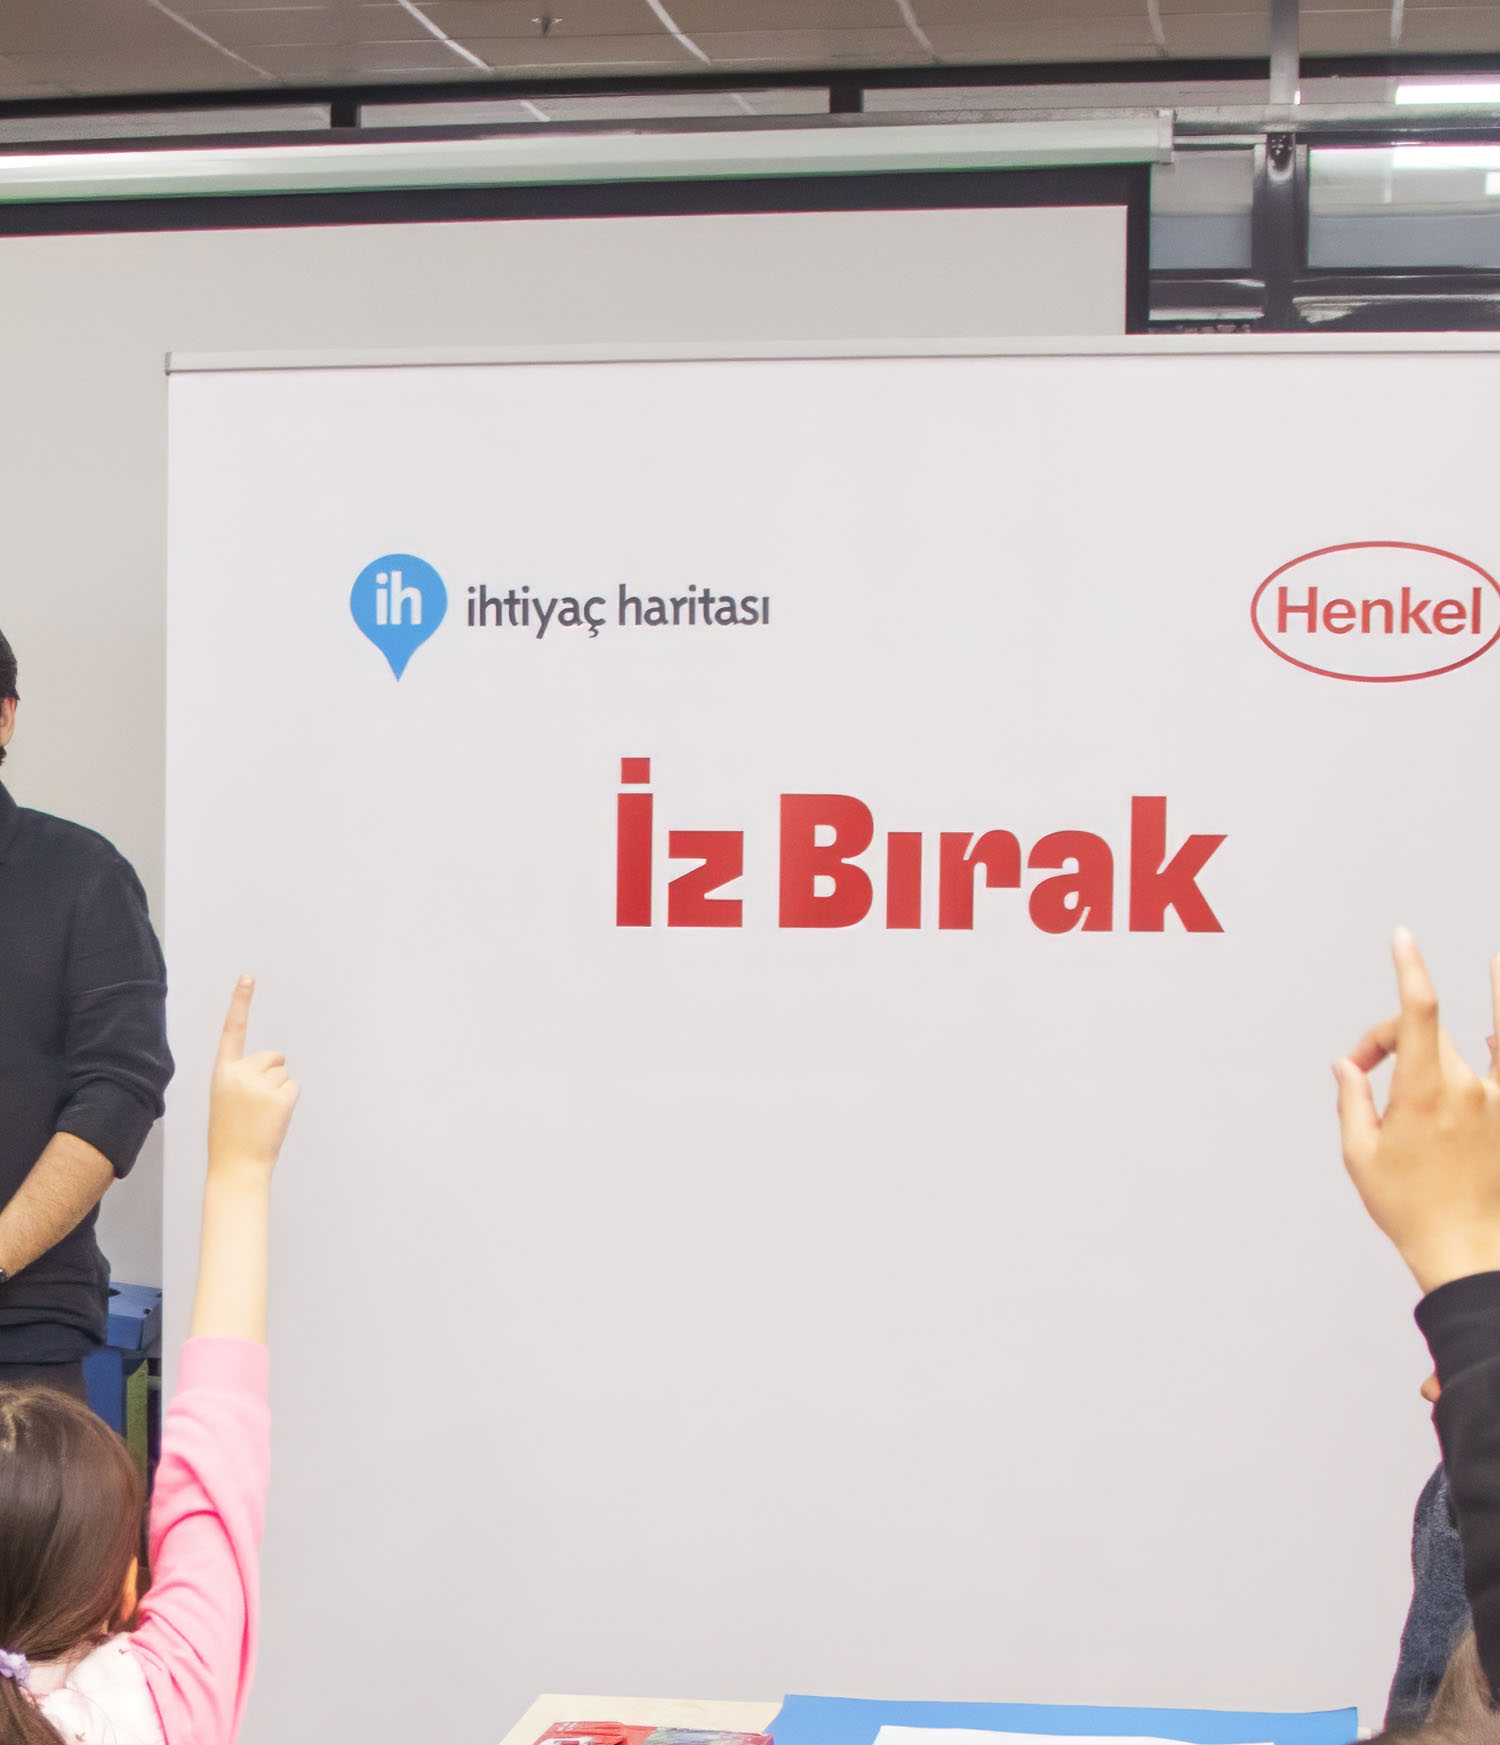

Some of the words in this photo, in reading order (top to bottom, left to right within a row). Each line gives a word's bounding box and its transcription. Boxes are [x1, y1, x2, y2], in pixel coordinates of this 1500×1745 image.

[376, 570, 422, 625] ih
[468, 585, 605, 639] ihtiyaç
[619, 584, 768, 625] haritası
[1277, 586, 1482, 636] Henkel
[616, 757, 743, 928] İz
[778, 794, 1226, 934] Bırak
